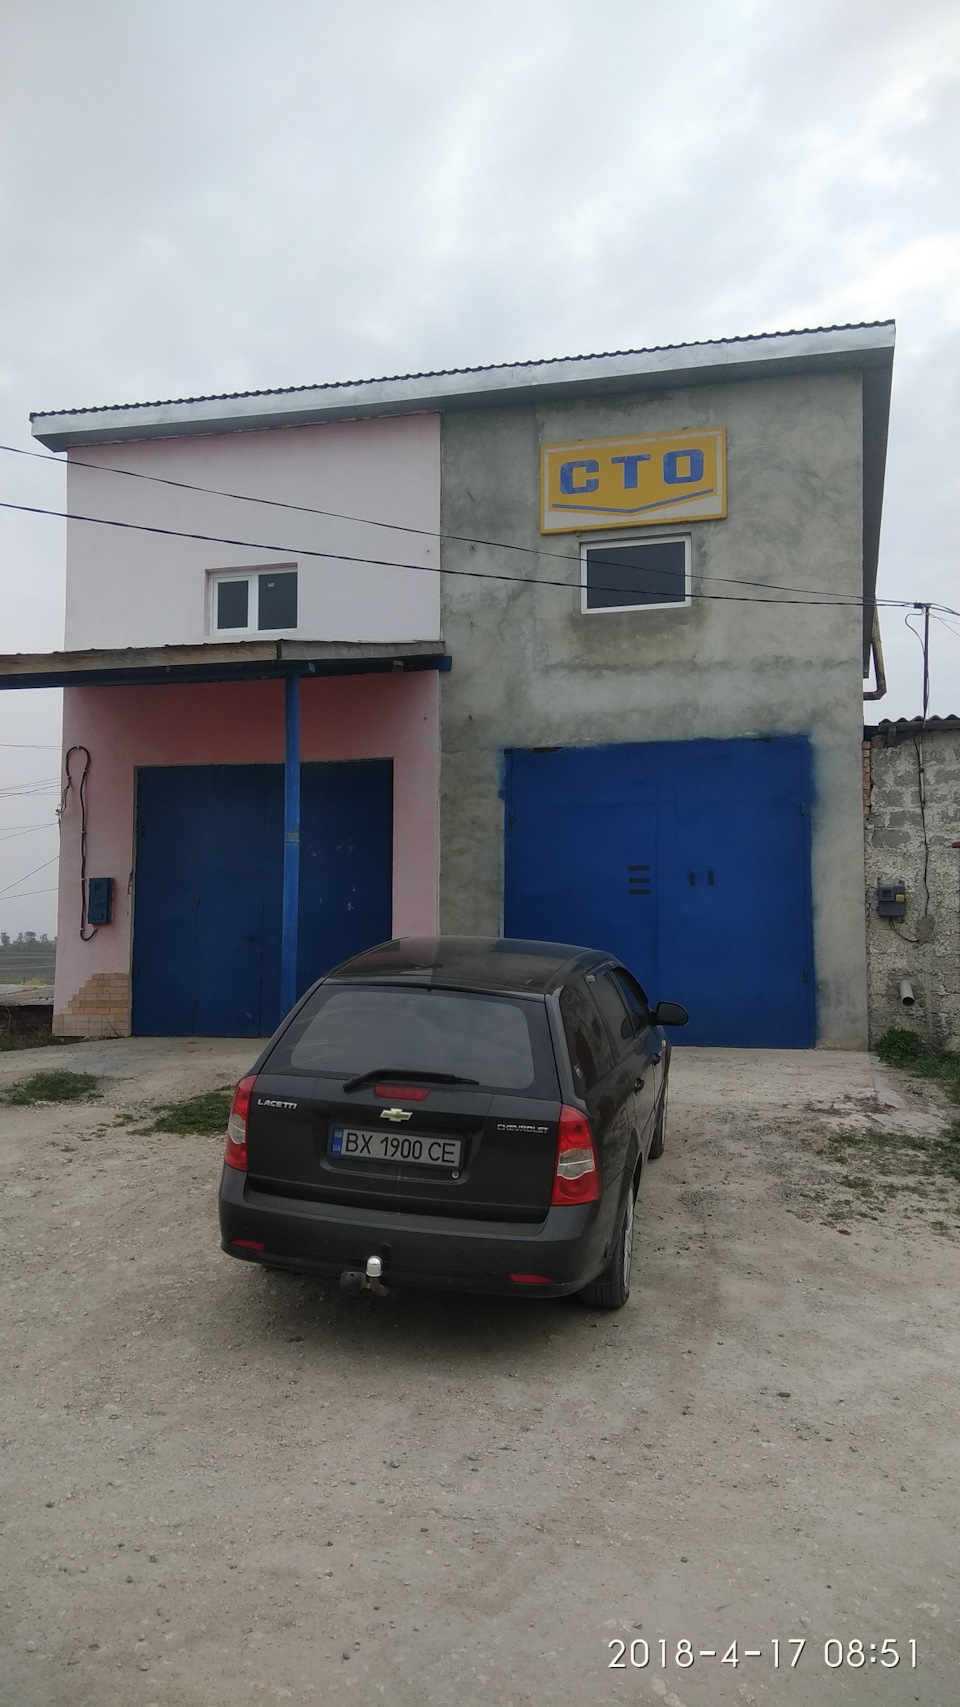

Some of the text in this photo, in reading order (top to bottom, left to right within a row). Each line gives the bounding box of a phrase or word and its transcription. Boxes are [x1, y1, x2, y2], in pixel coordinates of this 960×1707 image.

[559, 448, 704, 495] СТО
[257, 1098, 298, 1110] LACETTI
[496, 1123, 549, 1134] CHEVROLET
[345, 1132, 456, 1163] BX 1900 CE
